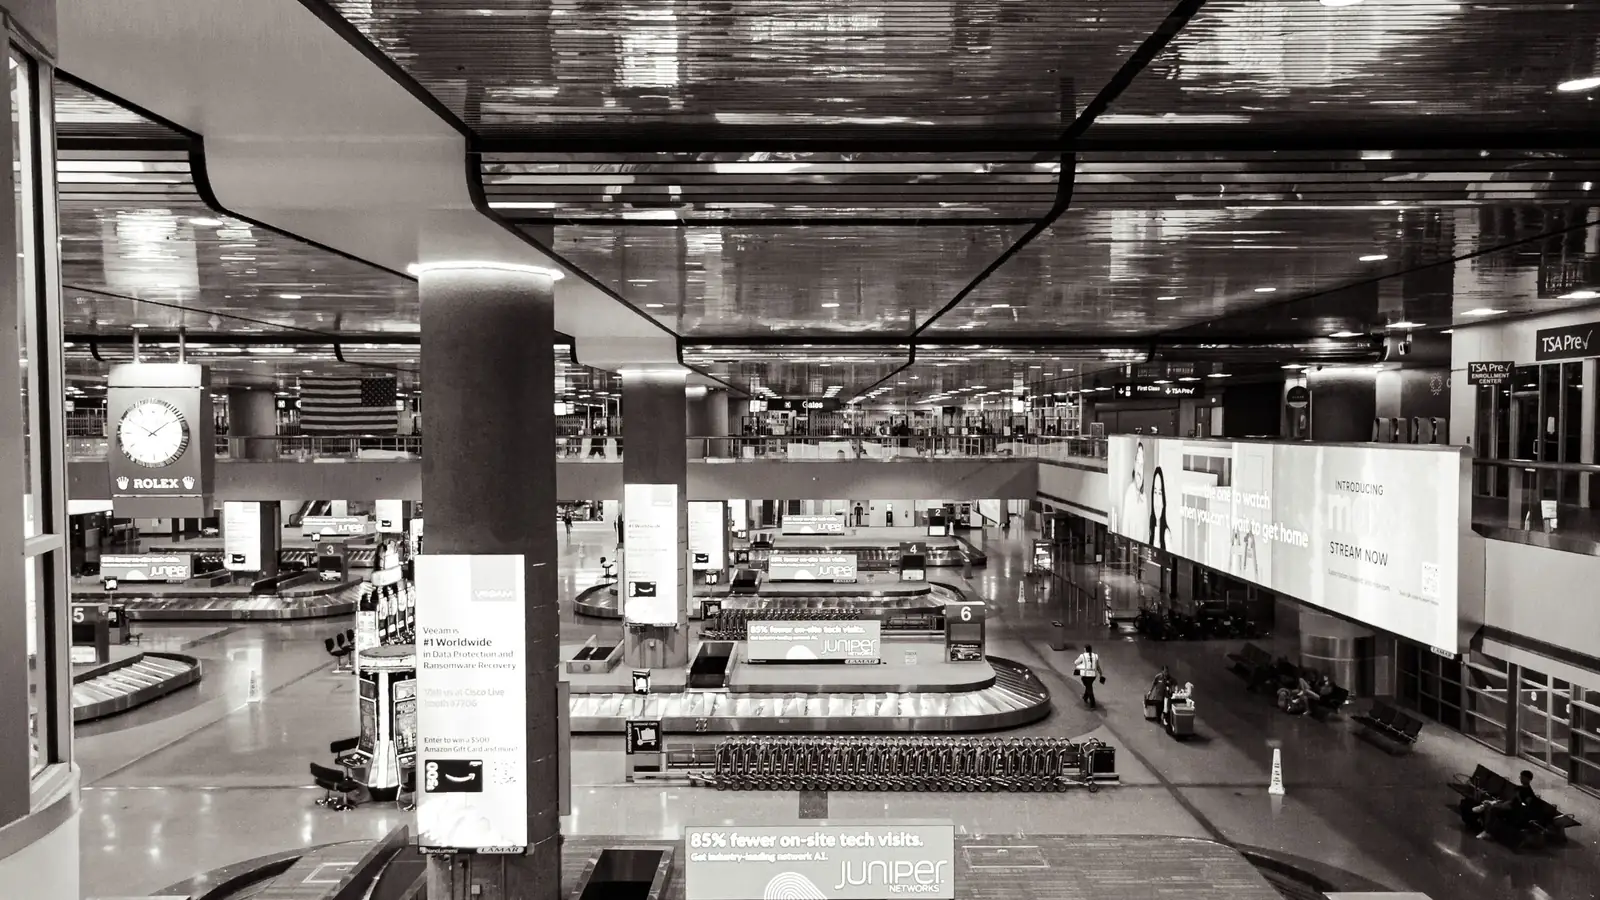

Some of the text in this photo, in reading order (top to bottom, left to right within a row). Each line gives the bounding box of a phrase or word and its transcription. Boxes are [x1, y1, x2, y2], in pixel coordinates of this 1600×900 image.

[1542, 336, 1563, 353] TSA
[1470, 363, 1488, 373] TSA
[1171, 387, 1182, 395] TSA
[133, 478, 180, 489] ROLEX
[1334, 479, 1384, 496] INTRODUCING
[1204, 483, 1216, 499] the
[1216, 488, 1231, 503] one
[1242, 490, 1271, 510] watch
[935, 508, 941, 516] 2
[1231, 514, 1251, 533] wait
[1251, 516, 1261, 536] to
[1262, 523, 1279, 544] get
[1280, 522, 1310, 548] home
[326, 544, 334, 556] 3
[909, 544, 918, 555] 4
[1329, 540, 1389, 567] STREAM NOW
[72, 608, 84, 622] 5
[960, 606, 972, 622] 6
[422, 626, 460, 635] Veeam is
[423, 637, 493, 647] #1 Worldwide
[423, 650, 514, 659] in Data Protection and
[423, 661, 517, 670] Ransomware Recovery
[487, 687, 505, 698] Live
[424, 736, 443, 744] Enter
[443, 736, 452, 744] to
[471, 736, 490, 744] $500
[690, 831, 924, 849] 85% fewer on-site tech visits.
[690, 852, 707, 862] Get
[777, 852, 813, 862] network
[889, 884, 940, 893] NETWORKS
